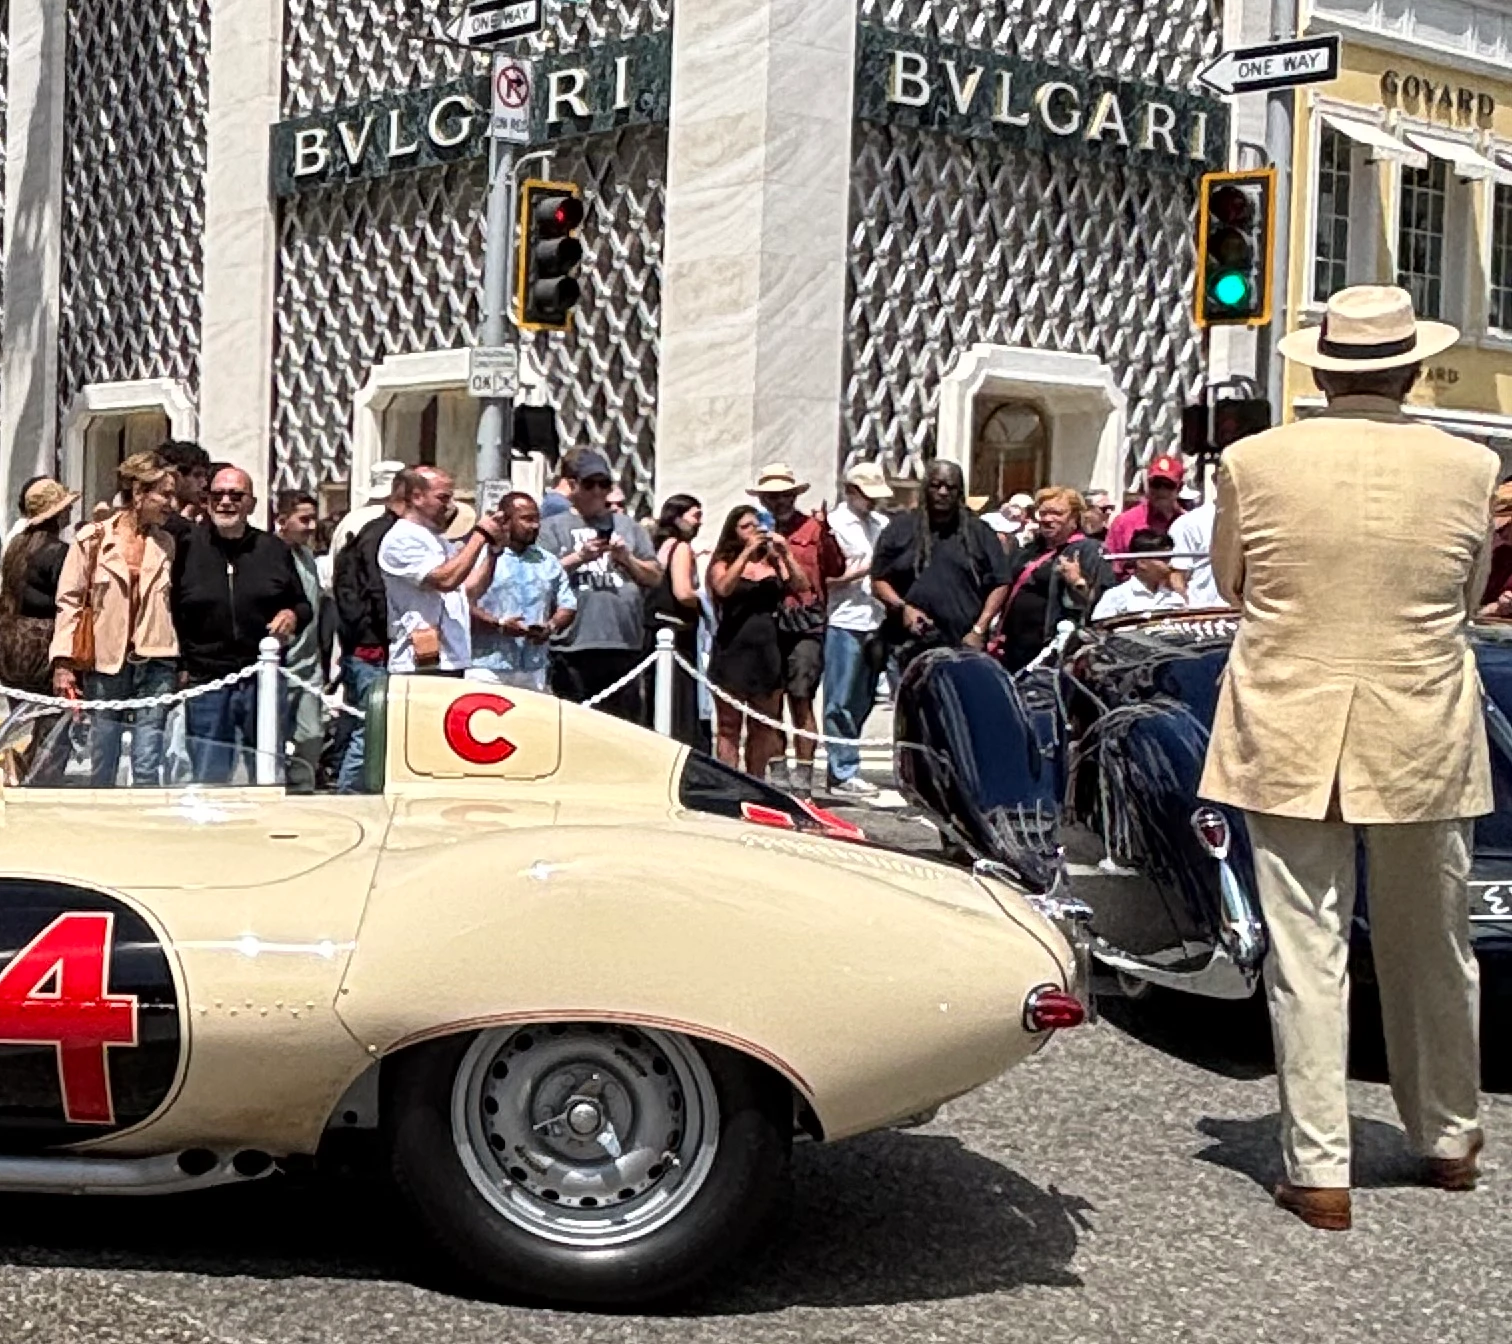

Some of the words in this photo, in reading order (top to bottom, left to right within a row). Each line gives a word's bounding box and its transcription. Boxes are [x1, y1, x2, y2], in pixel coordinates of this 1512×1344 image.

[471, 13, 501, 33] ONE
[504, 6, 531, 24] WAY
[1238, 58, 1274, 78] ONE
[1283, 52, 1321, 72] WAY
[294, 56, 631, 177] BVLGRI
[887, 49, 1209, 160] BVLGARI
[1380, 69, 1495, 117] GOYARD
[1424, 366, 1460, 384] ARD
[443, 691, 518, 765] C
